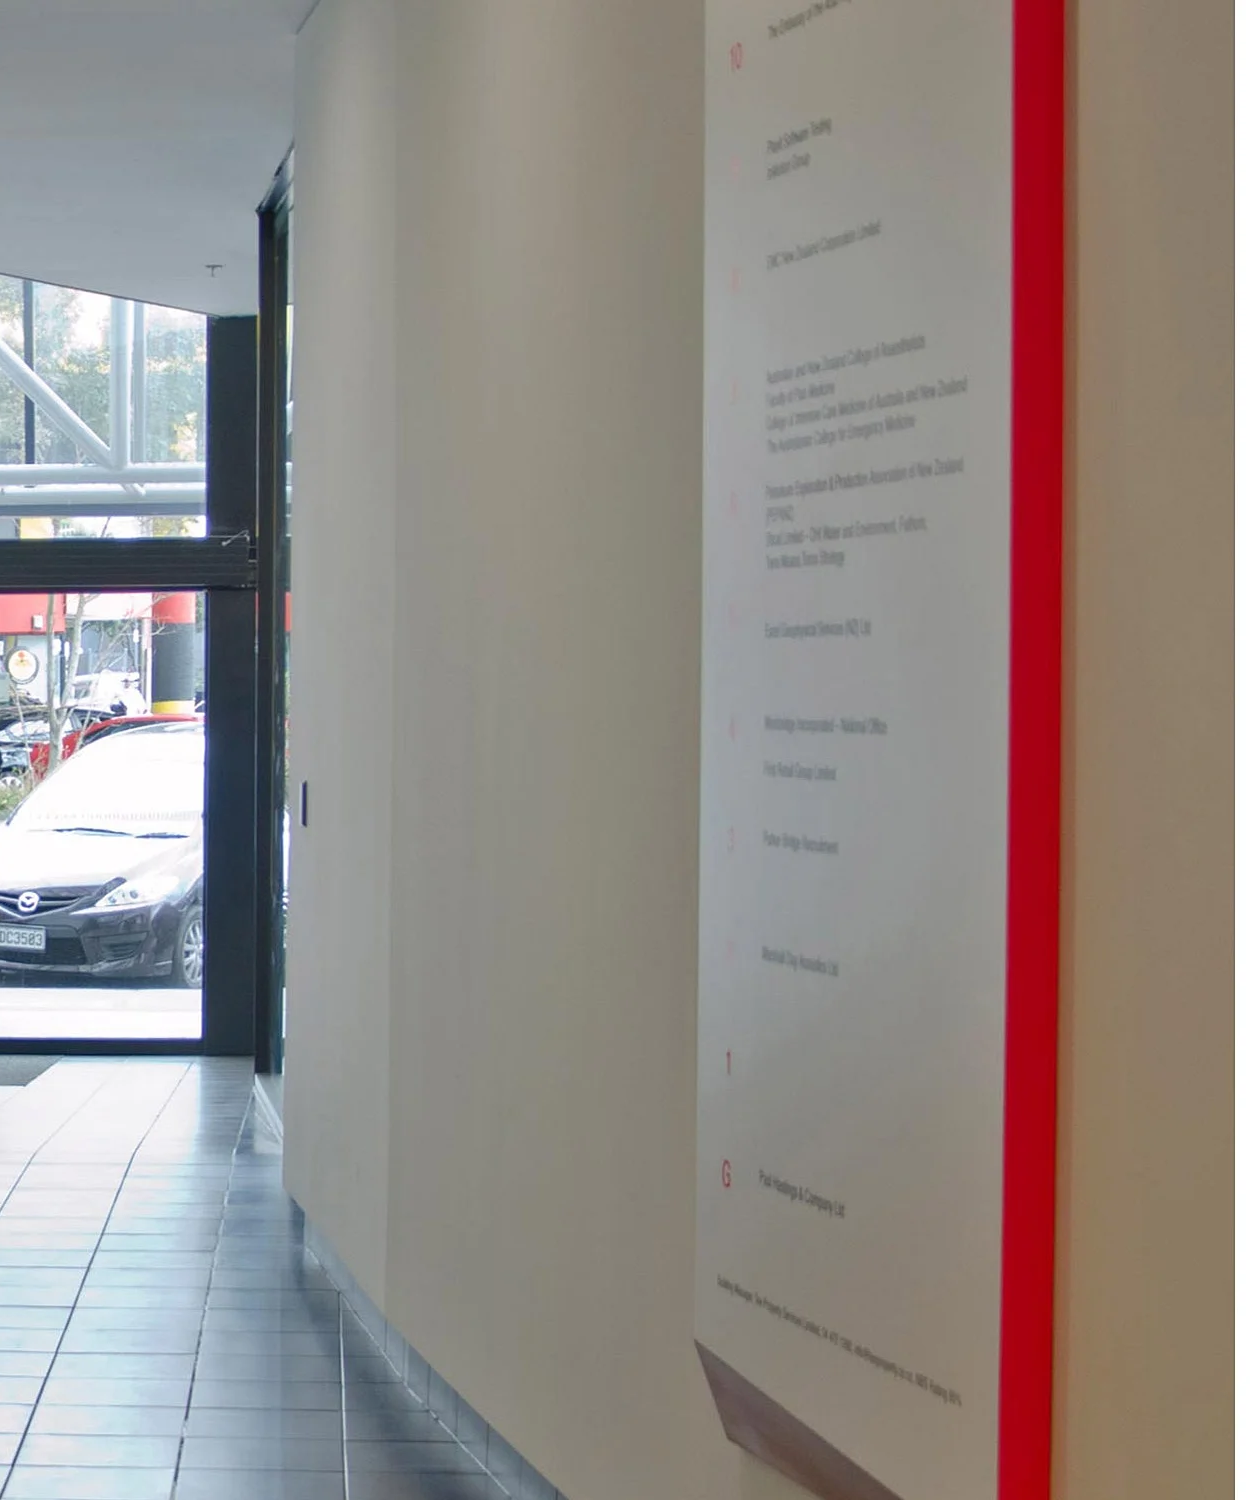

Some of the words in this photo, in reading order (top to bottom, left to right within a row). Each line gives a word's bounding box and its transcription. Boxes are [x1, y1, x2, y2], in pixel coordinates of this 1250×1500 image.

[795, 365, 806, 378] and
[807, 361, 820, 374] New
[821, 356, 846, 371] Zealand
[847, 349, 872, 366] College
[919, 384, 936, 400] New
[937, 376, 968, 398] Zealand
[917, 462, 932, 478] New
[934, 457, 964, 475] Zealand
[726, 1050, 732, 1075] 1
[722, 1158, 732, 1189] G
